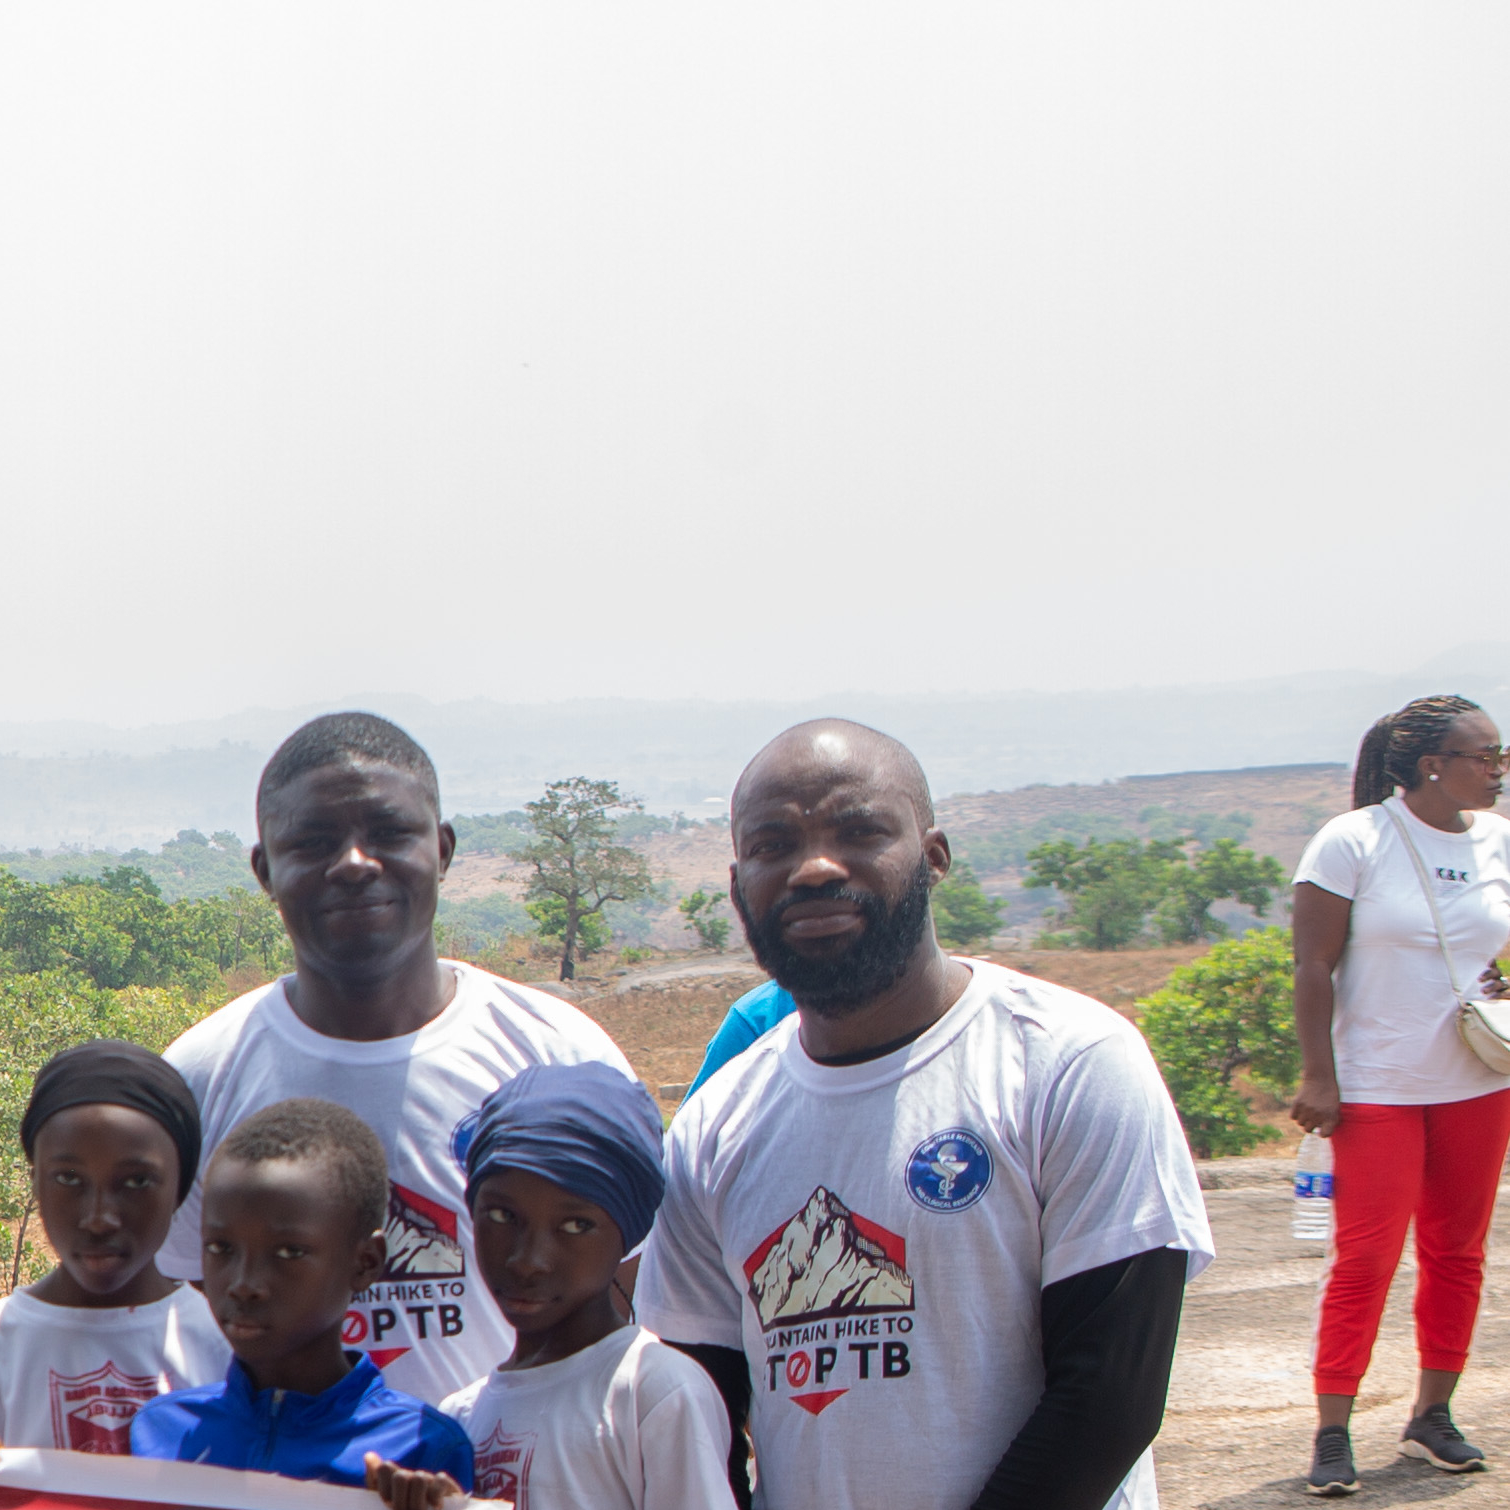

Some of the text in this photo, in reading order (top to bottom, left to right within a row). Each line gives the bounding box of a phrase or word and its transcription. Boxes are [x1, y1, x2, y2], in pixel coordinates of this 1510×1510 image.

[388, 1284, 433, 1301] HIKE
[437, 1282, 465, 1297] TO
[406, 1304, 463, 1340] TB
[834, 1318, 880, 1339] HIKE
[882, 1316, 913, 1334] TO
[848, 1341, 911, 1380] TB
